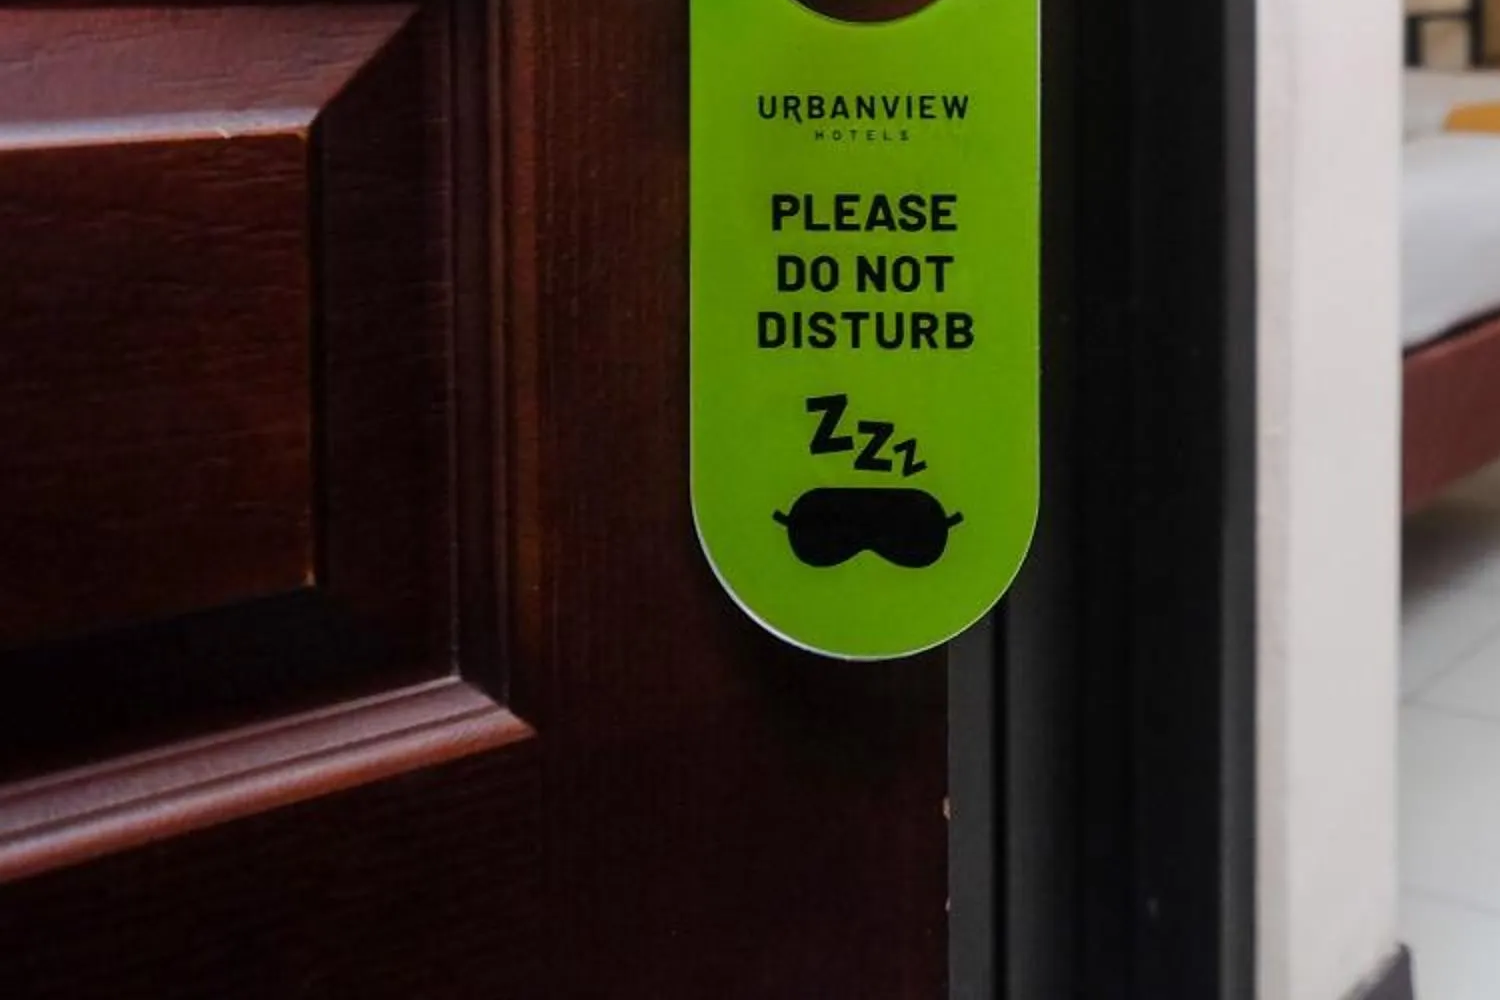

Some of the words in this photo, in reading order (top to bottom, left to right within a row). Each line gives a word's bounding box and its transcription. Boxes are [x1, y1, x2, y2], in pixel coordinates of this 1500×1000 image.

[757, 94, 969, 125] URBANVIEW
[813, 128, 911, 142] HOTELS
[770, 193, 958, 233] PLEASE
[776, 254, 840, 293] DO
[855, 254, 955, 293] NOT
[757, 310, 975, 351] DISTURB
